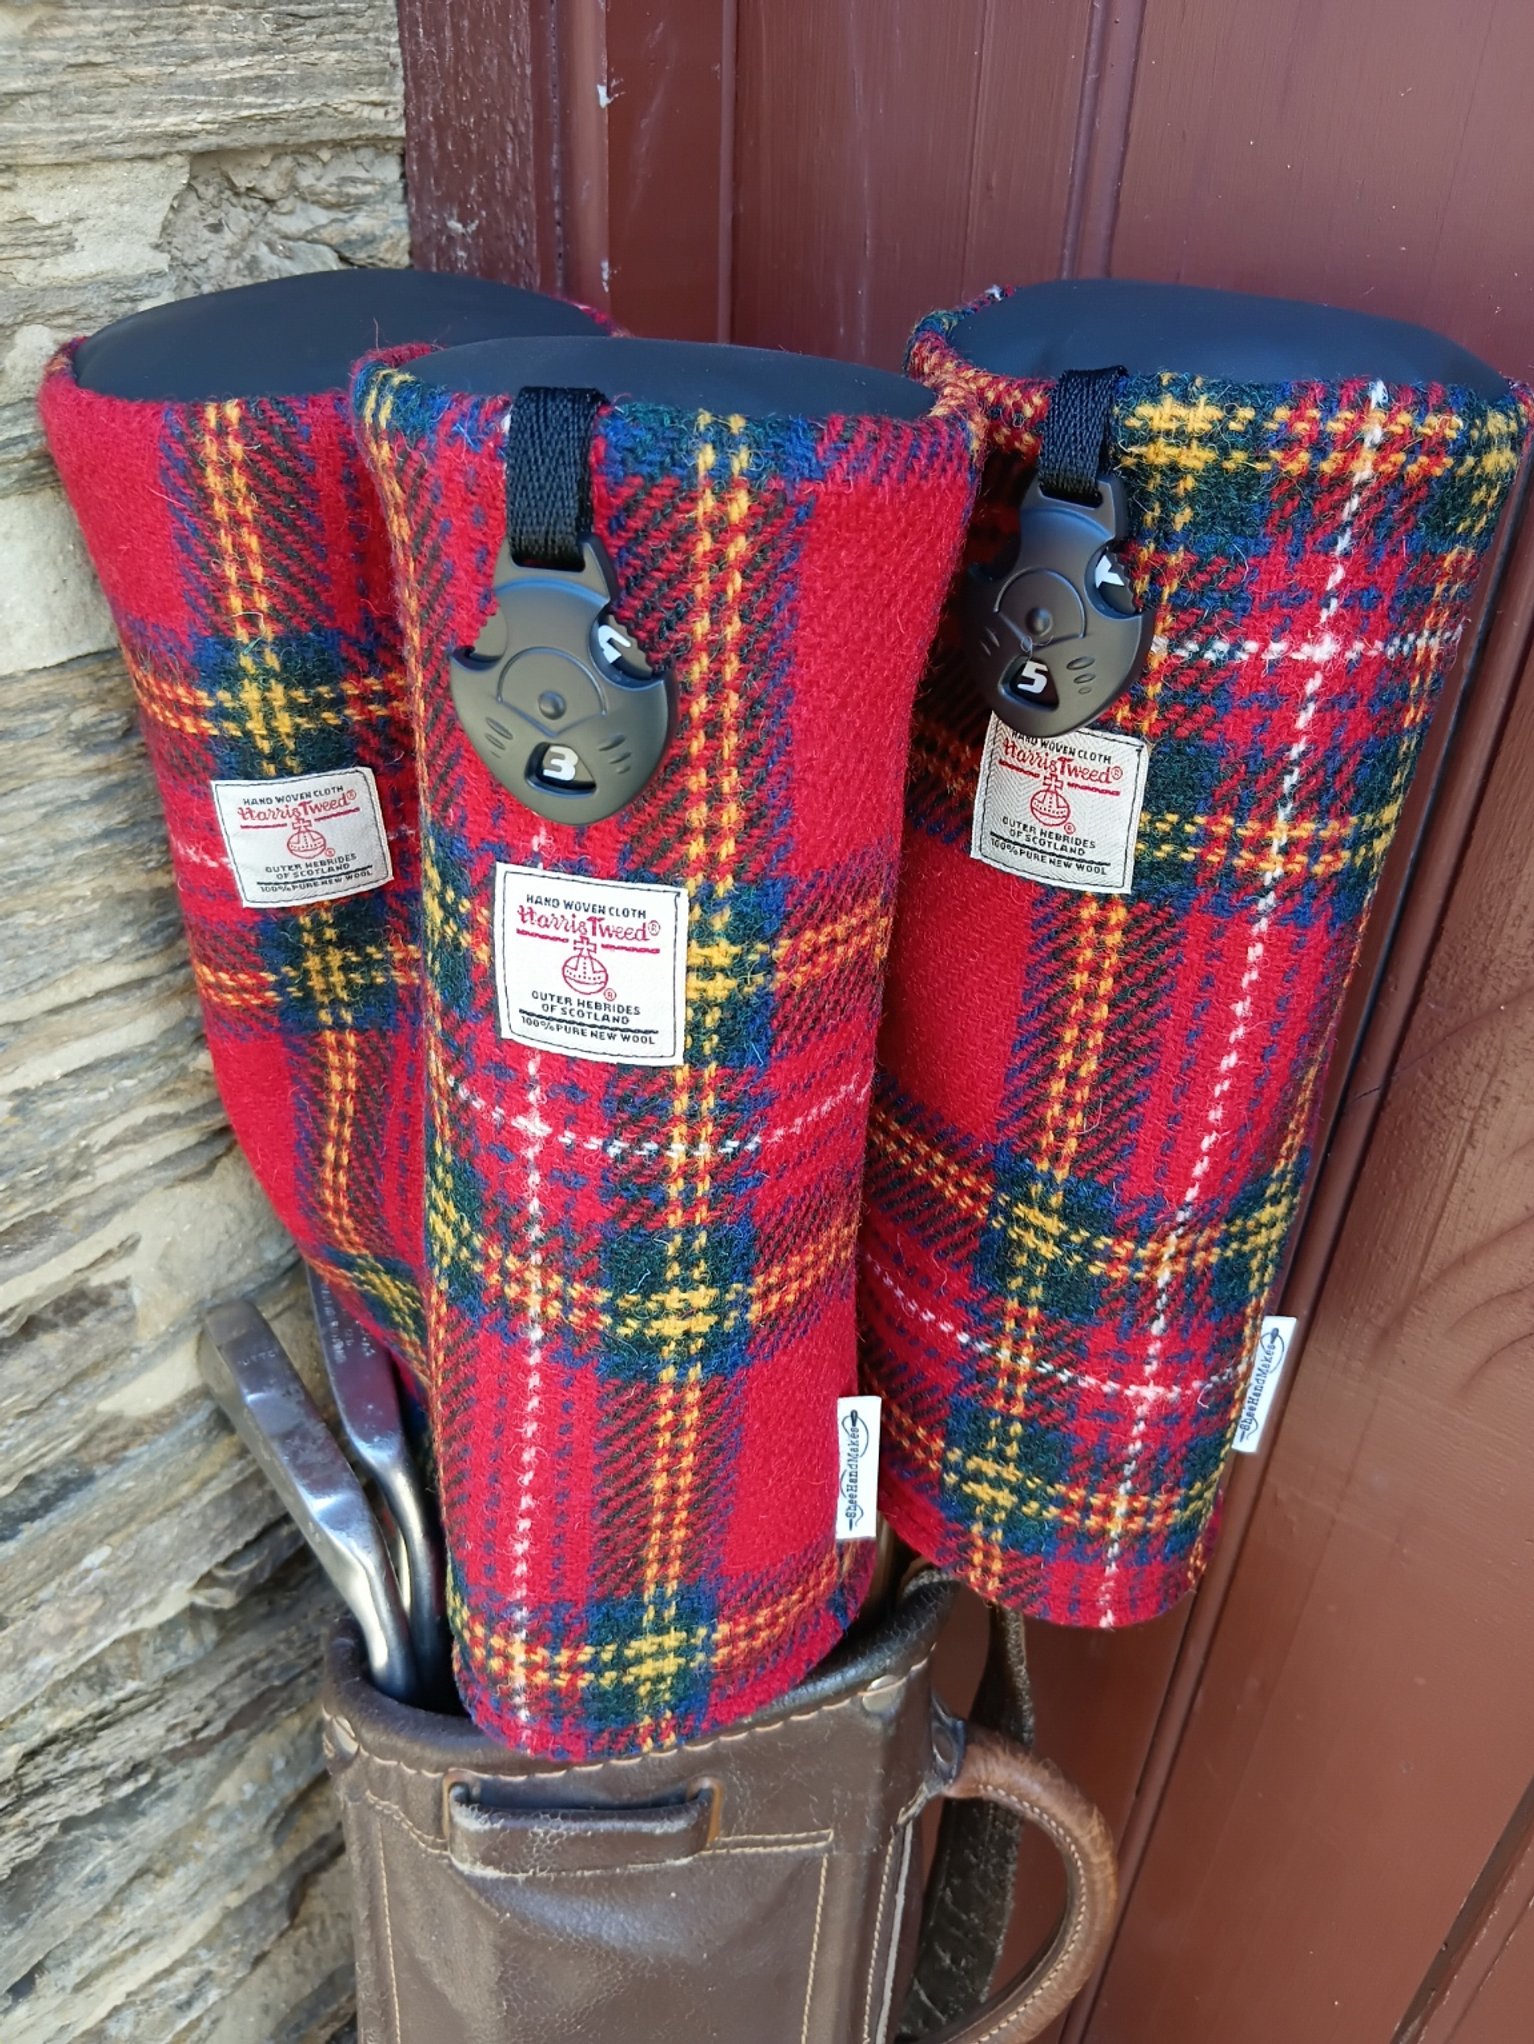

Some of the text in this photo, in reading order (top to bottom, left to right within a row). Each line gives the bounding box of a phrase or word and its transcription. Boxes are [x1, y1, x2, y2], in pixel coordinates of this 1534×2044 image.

[1017, 660, 1049, 694] 5
[542, 746, 579, 781] 3
[1003, 738, 1057, 772] Harris
[1040, 739, 1077, 757] WOVEN
[1078, 750, 1112, 764] CLOTH
[243, 785, 344, 806] HAND WOVEN CLOTH
[237, 804, 299, 821] Harris
[1002, 816, 1096, 849] OUTER HEBRIDES
[1009, 829, 1085, 856] OF SCOTLAND
[265, 853, 357, 874] OUTER HEBRIDES
[276, 862, 350, 880] OF SCOTLAND
[1049, 858, 1073, 869] NEW
[1076, 863, 1107, 876] WOOL
[321, 876, 343, 887] NEW
[345, 870, 373, 881] WOOL
[526, 893, 646, 919] HAND WOVEN CLOTH
[517, 905, 587, 936] Harris
[531, 990, 641, 1015] OUTER HEBRIDES
[541, 1003, 630, 1025] OF SCOTLAND
[590, 1030, 617, 1041] NEW
[621, 1032, 655, 1044] WOOL
